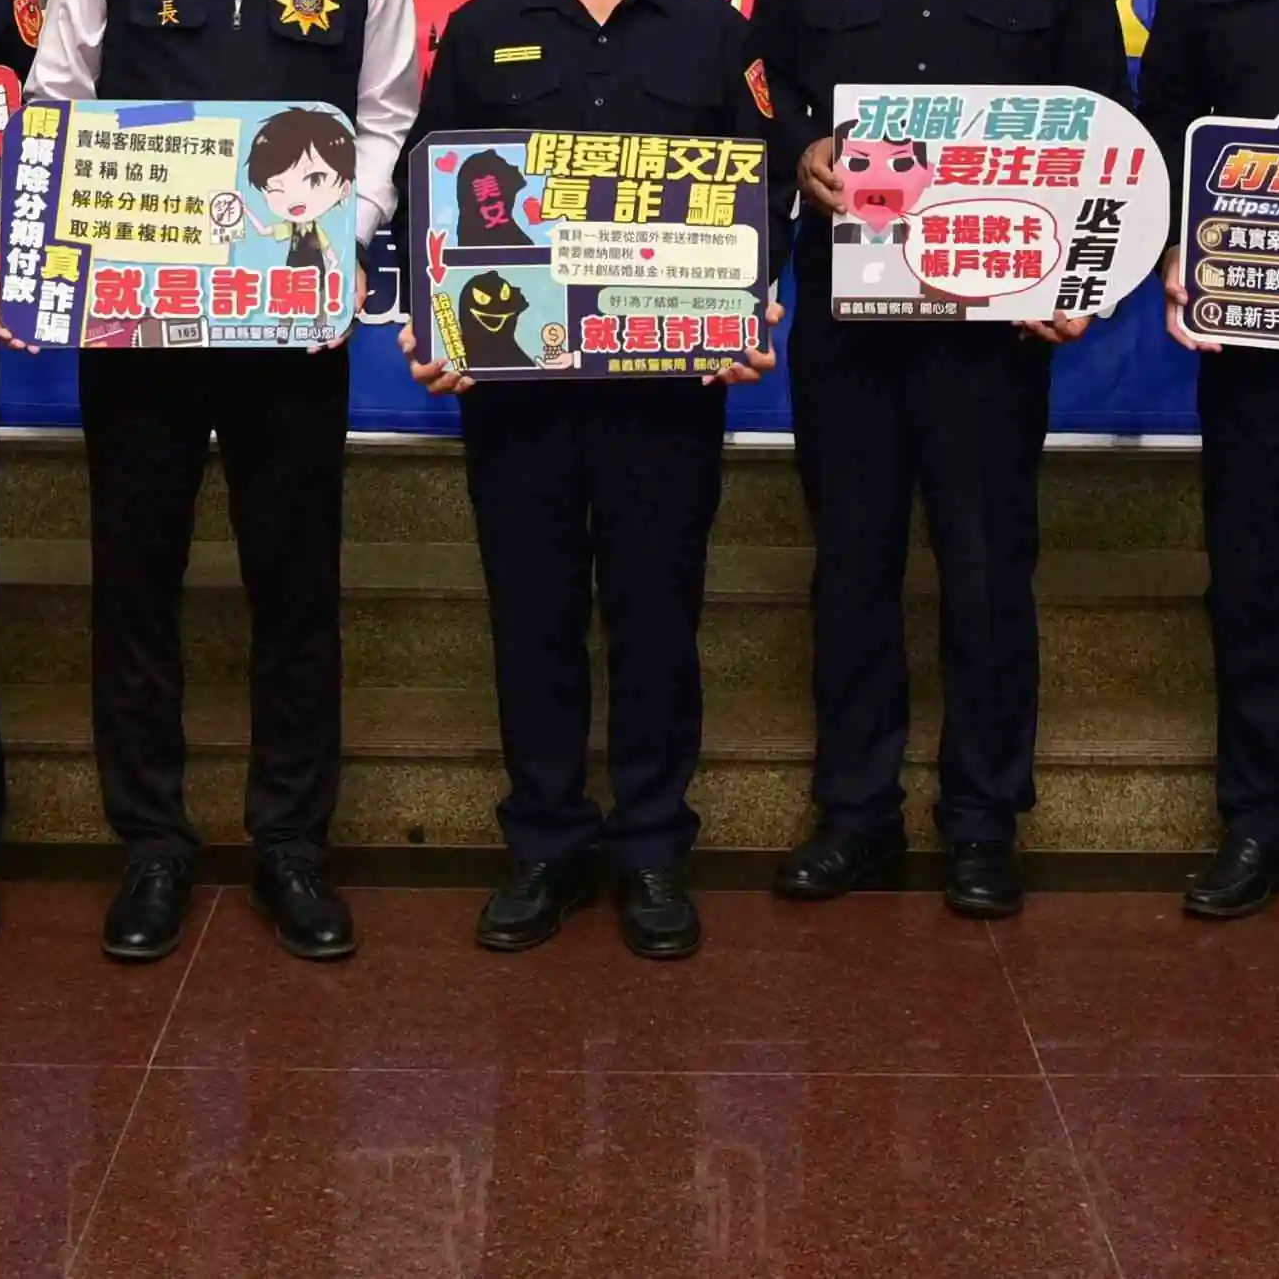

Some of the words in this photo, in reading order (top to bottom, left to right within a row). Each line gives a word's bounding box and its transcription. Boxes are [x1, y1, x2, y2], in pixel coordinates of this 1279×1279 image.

[851, 95, 1096, 142] 求職/貸款
[77, 129, 235, 157] 賣場客服或銀行來電
[526, 131, 766, 183] 假愛情交友
[75, 160, 169, 182] 聲稱協助
[933, 145, 1146, 187] 要注意!!
[2, 106, 60, 304] 假解除分期付款
[72, 190, 204, 216] 解除分期付款
[471, 174, 508, 230] 美女
[540, 175, 739, 226] 真詐騙
[69, 220, 203, 245] 取消重複扣款
[921, 215, 1042, 245] 寄提款卡
[920, 249, 1042, 279] 帳戶存摺
[1054, 197, 1128, 311] 必有詐
[34, 244, 82, 344] 真詐騙
[93, 266, 342, 317] 就是詐騙!
[178, 327, 197, 338] 165
[581, 314, 759, 352] 就是詐騙!
